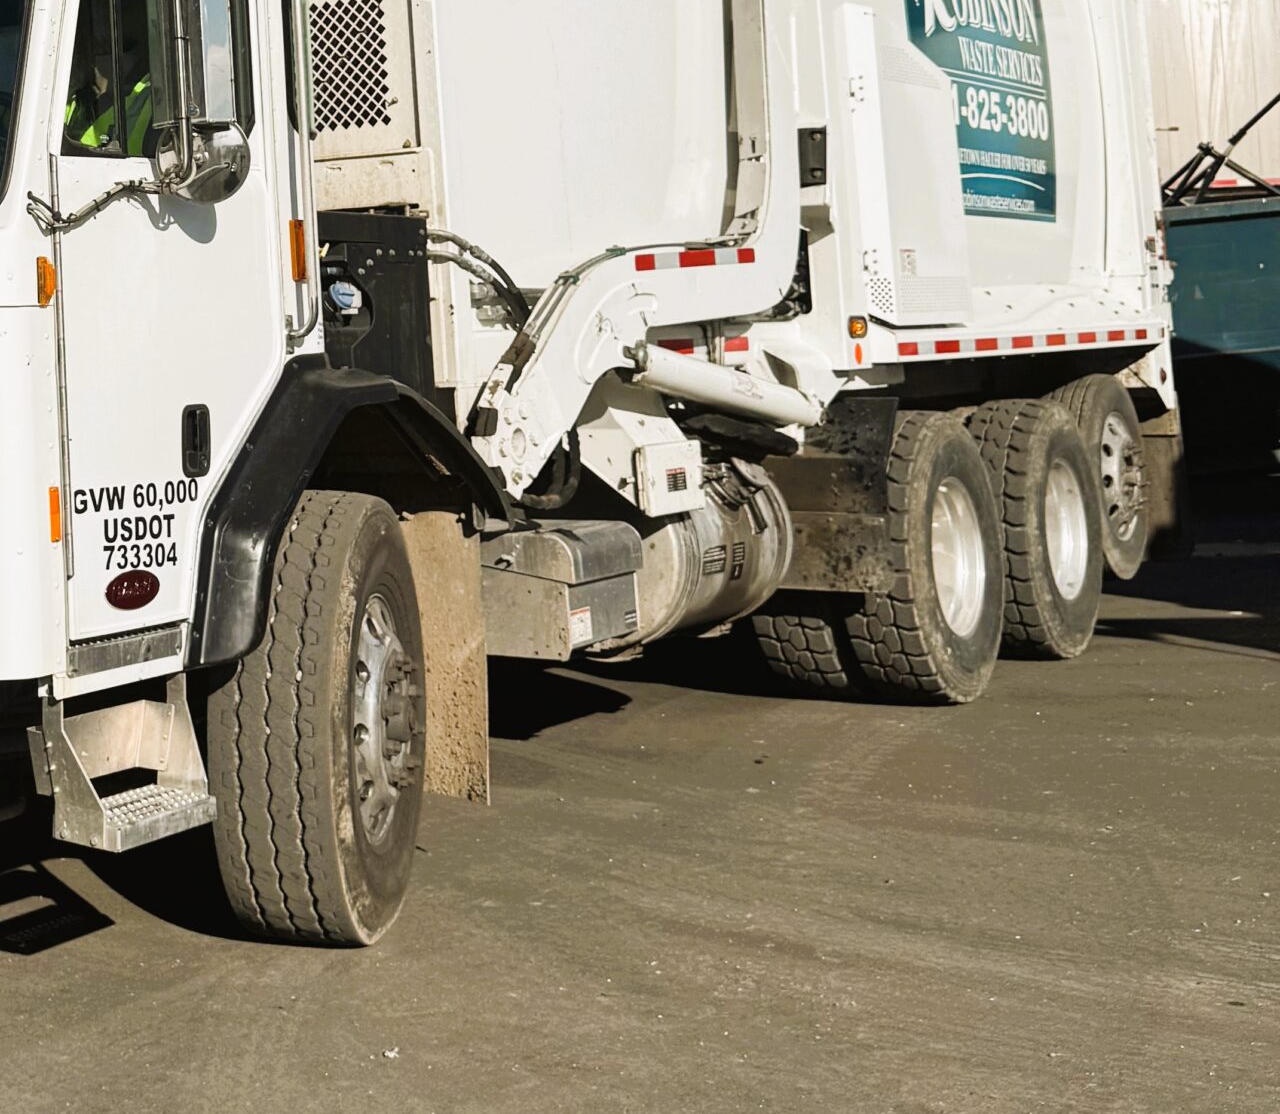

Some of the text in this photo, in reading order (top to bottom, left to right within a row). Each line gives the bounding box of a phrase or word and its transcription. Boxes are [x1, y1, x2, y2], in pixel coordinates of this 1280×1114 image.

[957, 35, 1043, 86] WASTE SERVICES
[951, 83, 1049, 141] 1-825-3800
[961, 187, 1035, 211] obinsonwasteservices.com
[73, 478, 198, 514] GVW 60,000
[103, 513, 175, 543] USDOT
[103, 541, 178, 570] 733304
